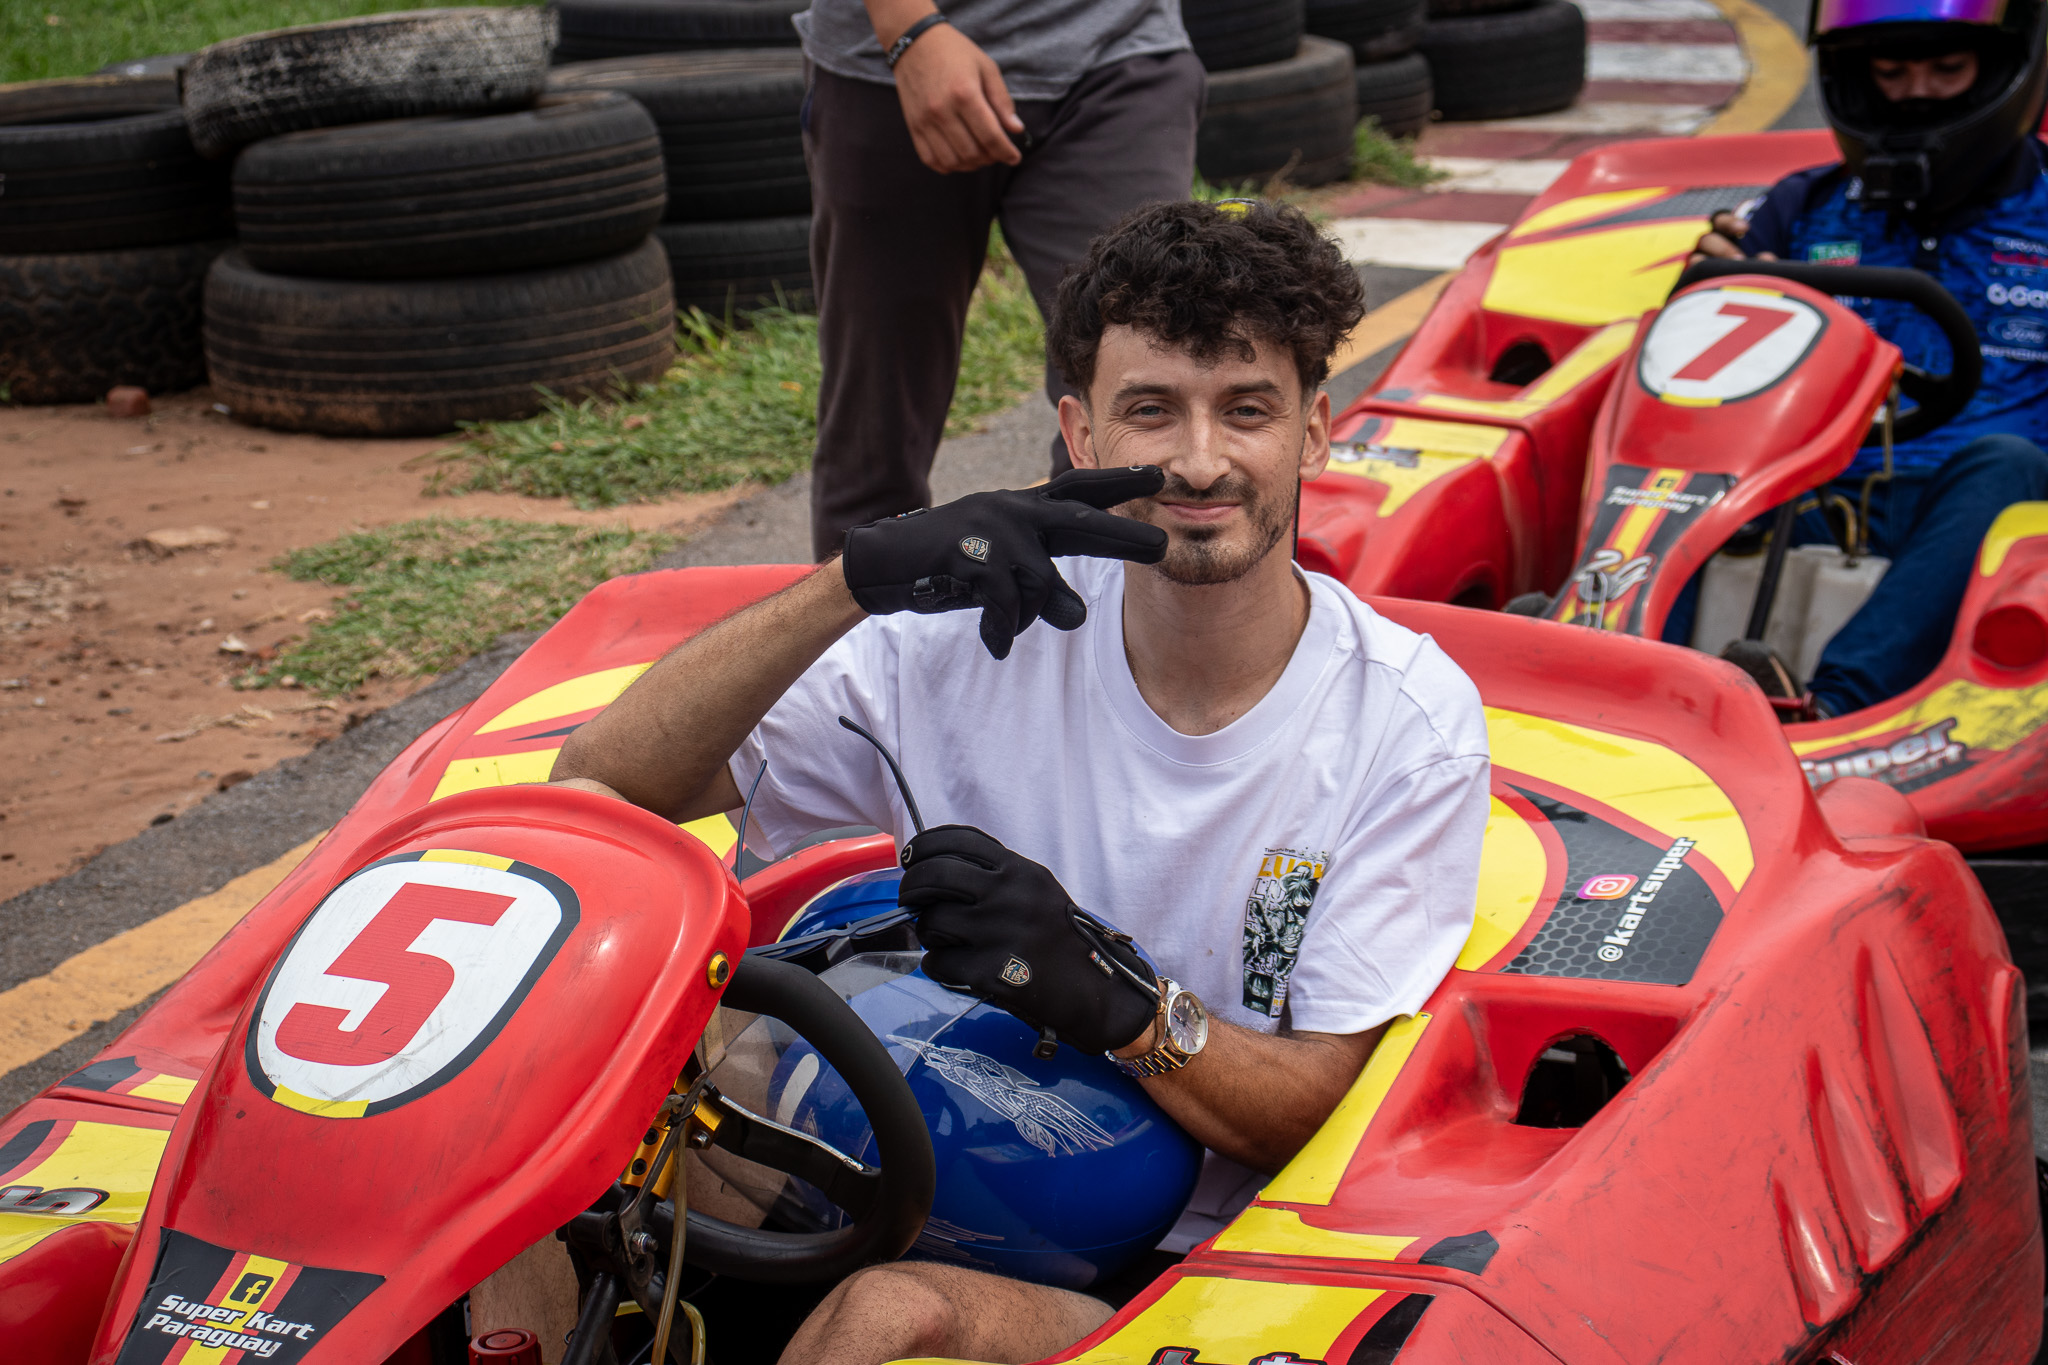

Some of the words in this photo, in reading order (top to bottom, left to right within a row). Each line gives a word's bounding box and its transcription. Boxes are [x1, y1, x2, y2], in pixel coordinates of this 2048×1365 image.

[1671, 302, 1797, 381] 7
[1597, 837, 1697, 962] @kartsuper
[275, 882, 517, 1067] 5
[143, 1313, 283, 1358] Paraguay
[157, 1294, 245, 1324] Super
[244, 1312, 316, 1341] Kart
